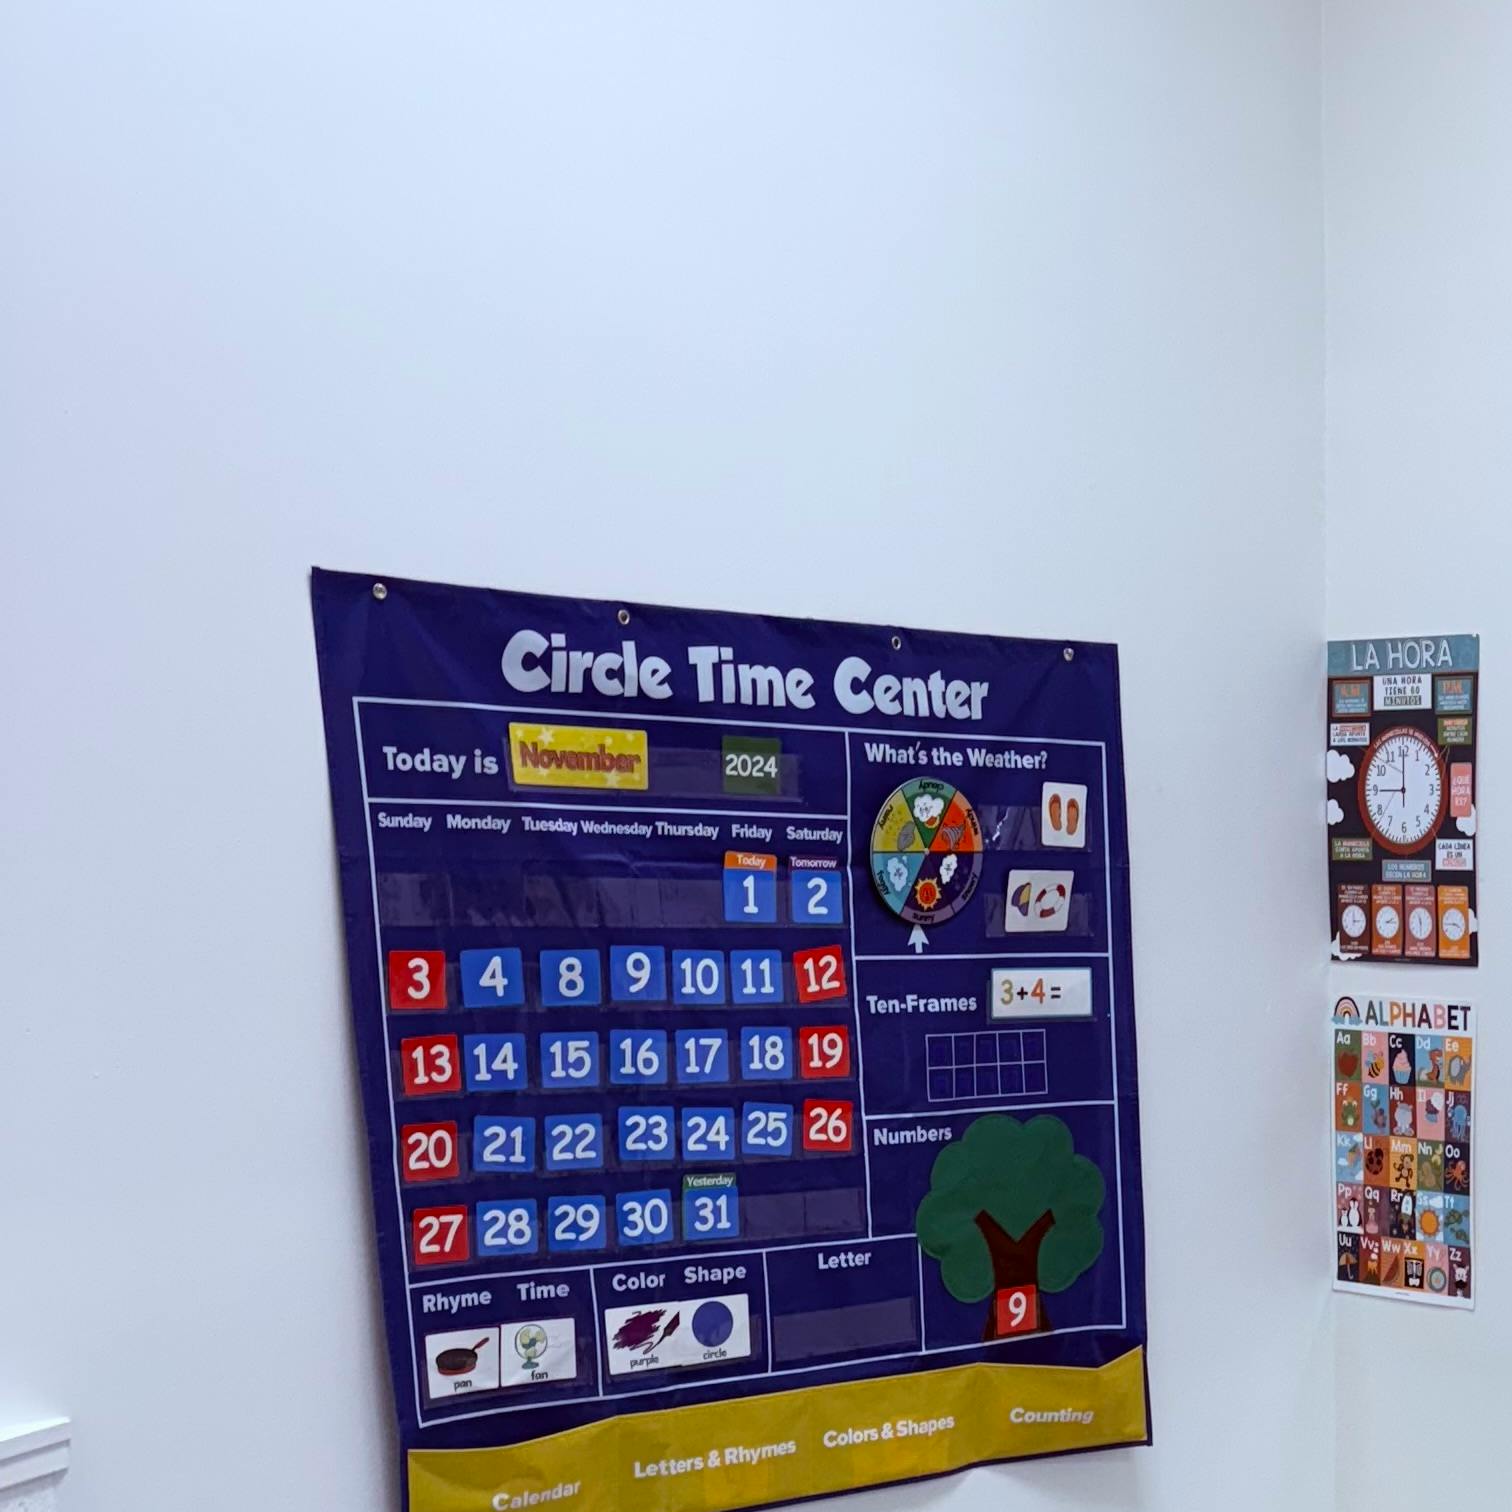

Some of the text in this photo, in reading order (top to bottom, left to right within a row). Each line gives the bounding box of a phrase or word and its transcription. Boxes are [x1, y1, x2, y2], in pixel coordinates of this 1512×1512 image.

[1352, 640, 1452, 671] LA HORA
[501, 630, 988, 720] Circle Time Center
[383, 741, 778, 780] Today is November 2024
[864, 741, 1048, 769] What's the Weather?
[377, 813, 843, 844] Sunday Monday Tuesday Wednesday Thursday Friday Saturday
[736, 855, 766, 868] Today
[790, 857, 836, 869] Tomorrow
[742, 876, 828, 914] 1 2
[407, 953, 841, 999] 3 4 8 9 10 11 12
[866, 994, 977, 1014] Ten-Frames
[1365, 1000, 1470, 1031] ALPHABET
[1389, 1035, 1402, 1047] Cc
[412, 1033, 843, 1085] 13 14 15 16 17 18 19
[873, 1126, 952, 1145] Numbers
[687, 1175, 733, 1187] Yesterday
[419, 1195, 731, 1253] 27 28 29 30 31
[818, 1250, 871, 1270] Letter
[612, 1266, 747, 1292] Color Shape
[423, 1282, 570, 1314] Rhyme Time
[1008, 1292, 1027, 1326] 9
[702, 1348, 728, 1360] circle
[530, 1369, 548, 1381] fan
[1010, 1408, 1094, 1424] Counting
[823, 1416, 955, 1448] Colors & Shapes
[634, 1441, 796, 1478] Letters & Rhymes
[492, 1481, 581, 1512] Calendar
